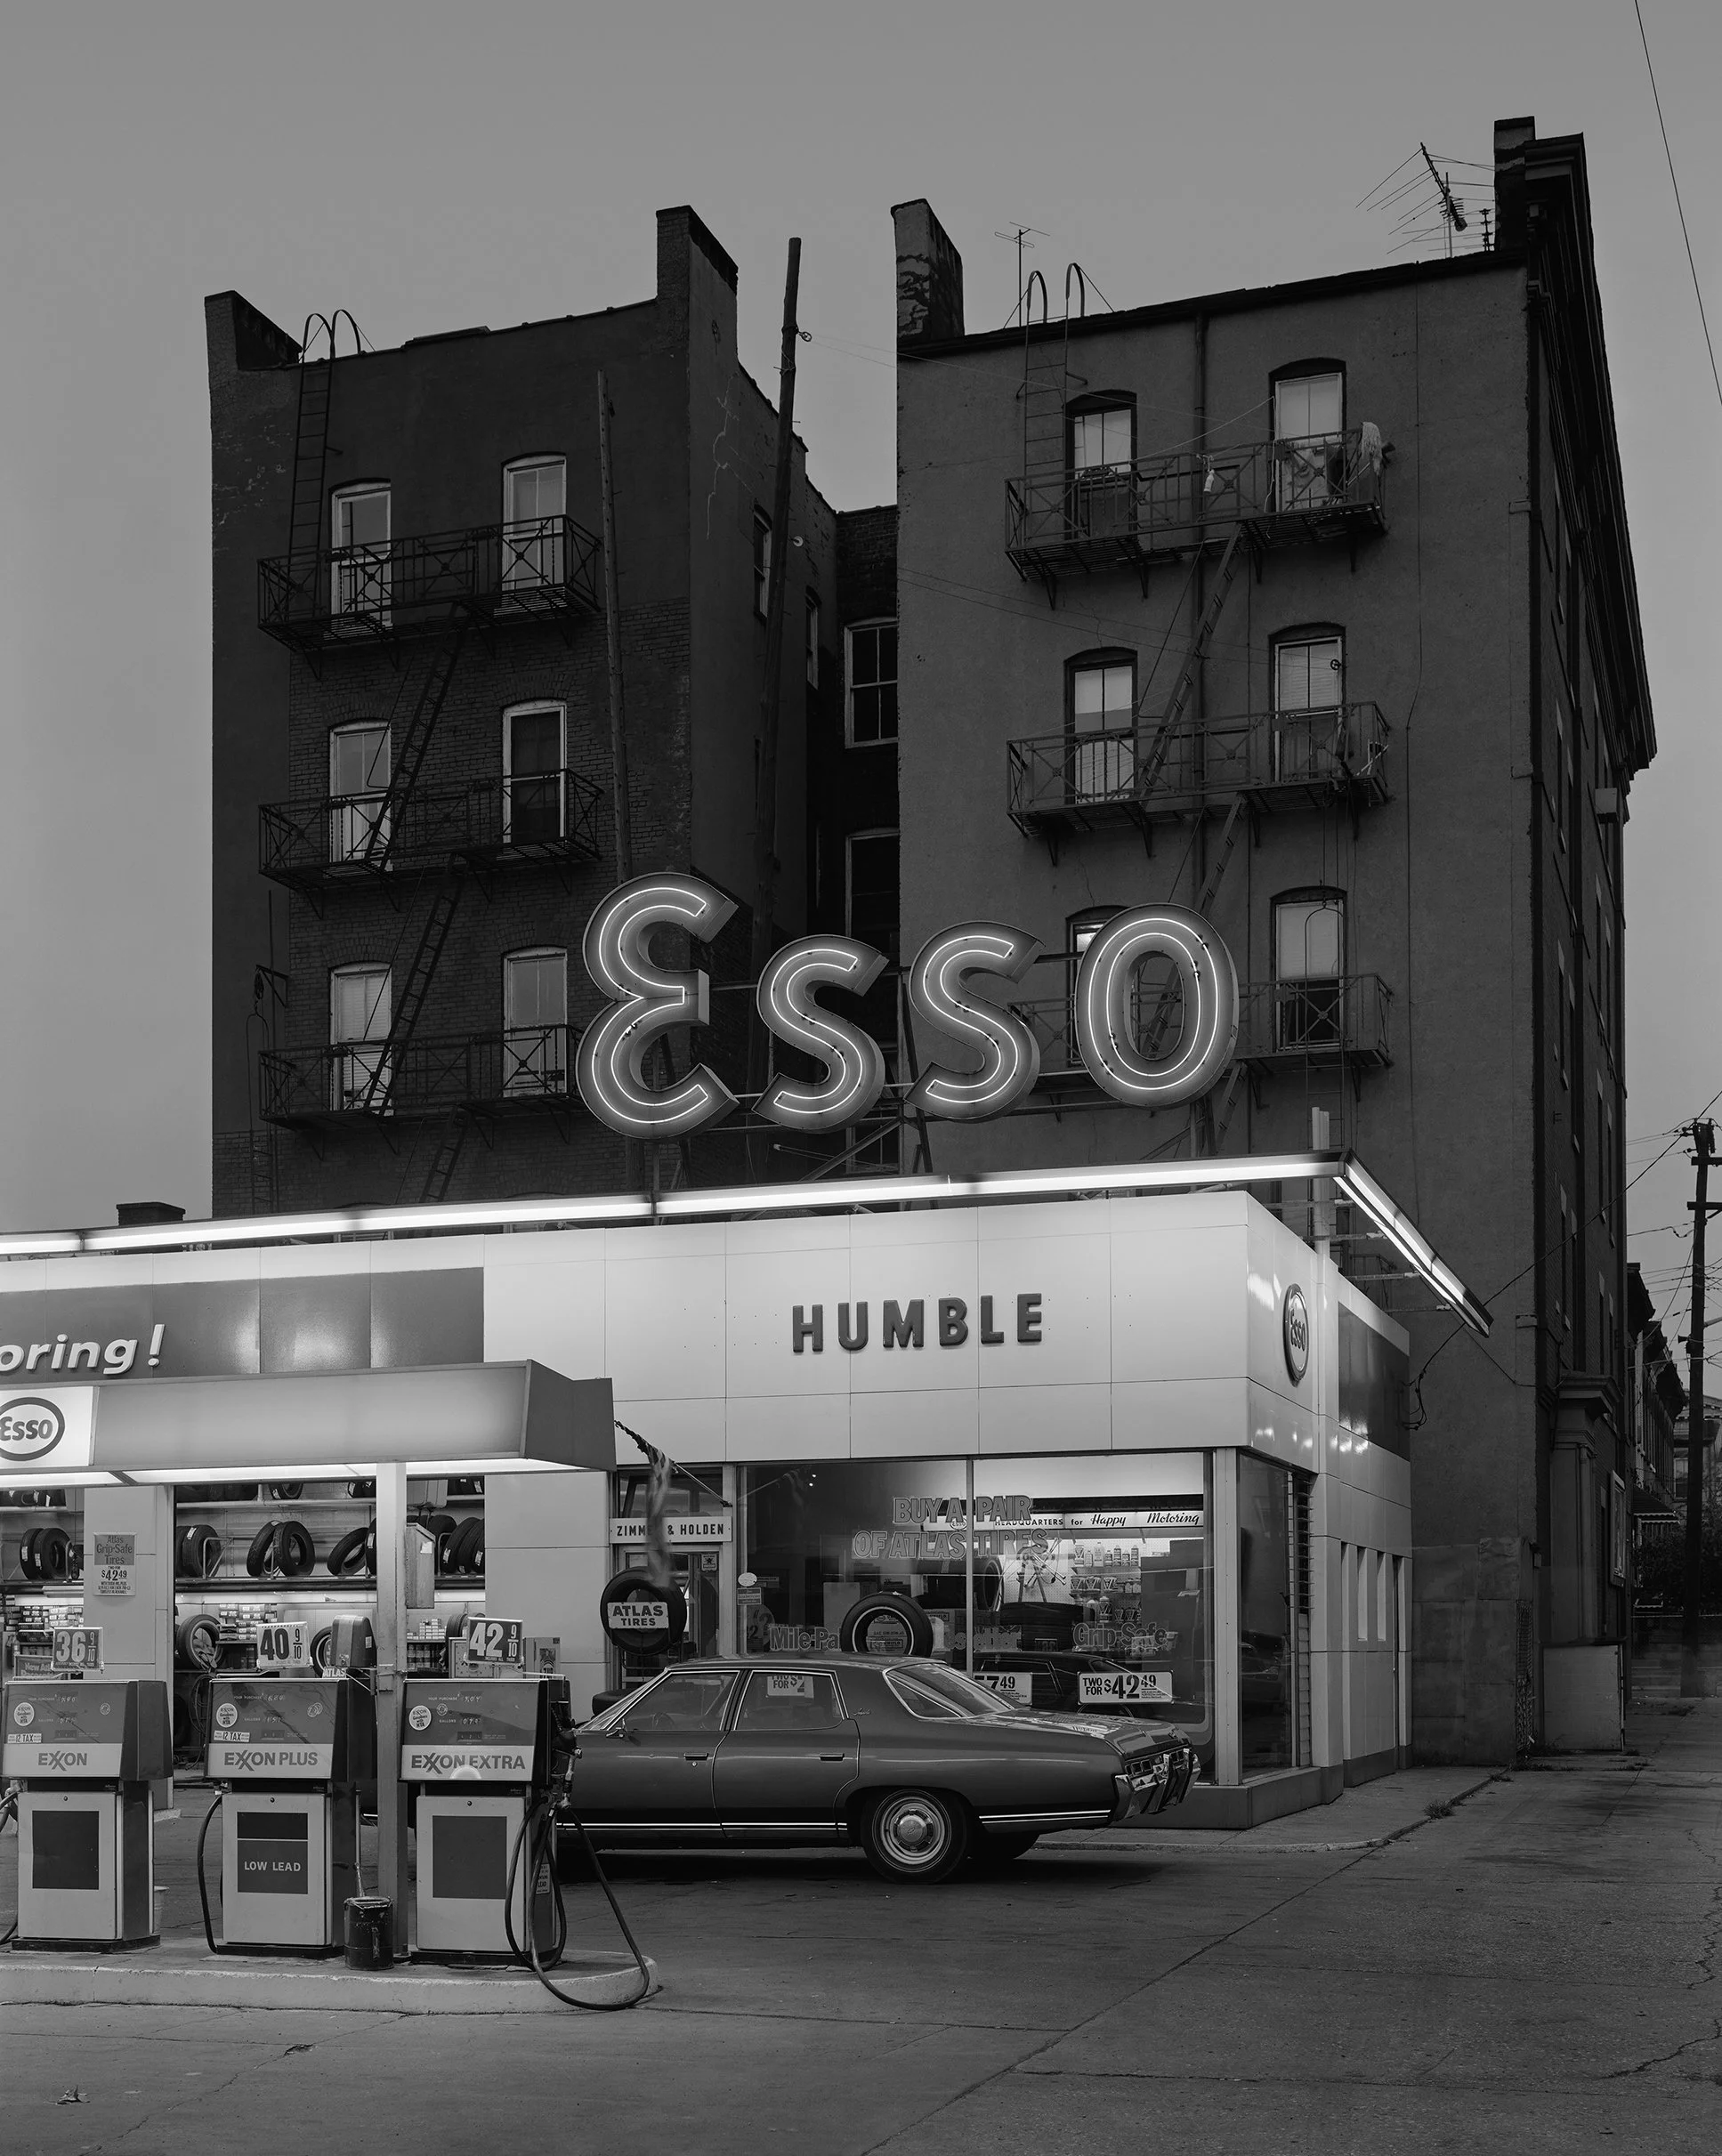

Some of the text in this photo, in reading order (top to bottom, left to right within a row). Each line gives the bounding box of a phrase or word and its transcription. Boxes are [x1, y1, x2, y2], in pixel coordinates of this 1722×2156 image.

[792, 1293, 1043, 1353] HUMBLE
[893, 1495, 1032, 1523] BUY A PAIR
[1071, 1518, 1083, 1526] for
[1090, 1514, 1126, 1527] Happy
[1147, 1512, 1200, 1525] Motoring
[617, 1524, 724, 1536] ZIMME & HOLDEN
[107, 1535, 124, 1543] Atlas
[853, 1529, 1048, 1558] OF ATLAS TIRES
[96, 1544, 133, 1555] Grip-Safe
[105, 1554, 125, 1564] Tires
[612, 1605, 664, 1616] ATLAS
[621, 1618, 656, 1626] TIRES
[470, 1622, 504, 1657] 42
[1072, 1622, 1167, 1651] Grip-Safe
[56, 1631, 86, 1662] 36
[260, 1628, 289, 1660] 40
[323, 1668, 346, 1677] ATLAS
[773, 1680, 789, 1688] FOR
[1083, 1678, 1102, 1687] TWO
[1086, 1687, 1102, 1695] FOR
[23, 1734, 33, 1742] TAX
[230, 1732, 241, 1741] TAX
[38, 1750, 87, 1771] EXXON
[224, 1749, 319, 1771] EXXON PLUS
[411, 1752, 525, 1774] EXXON EXTRA
[244, 1861, 301, 1871] LOW LEAD
